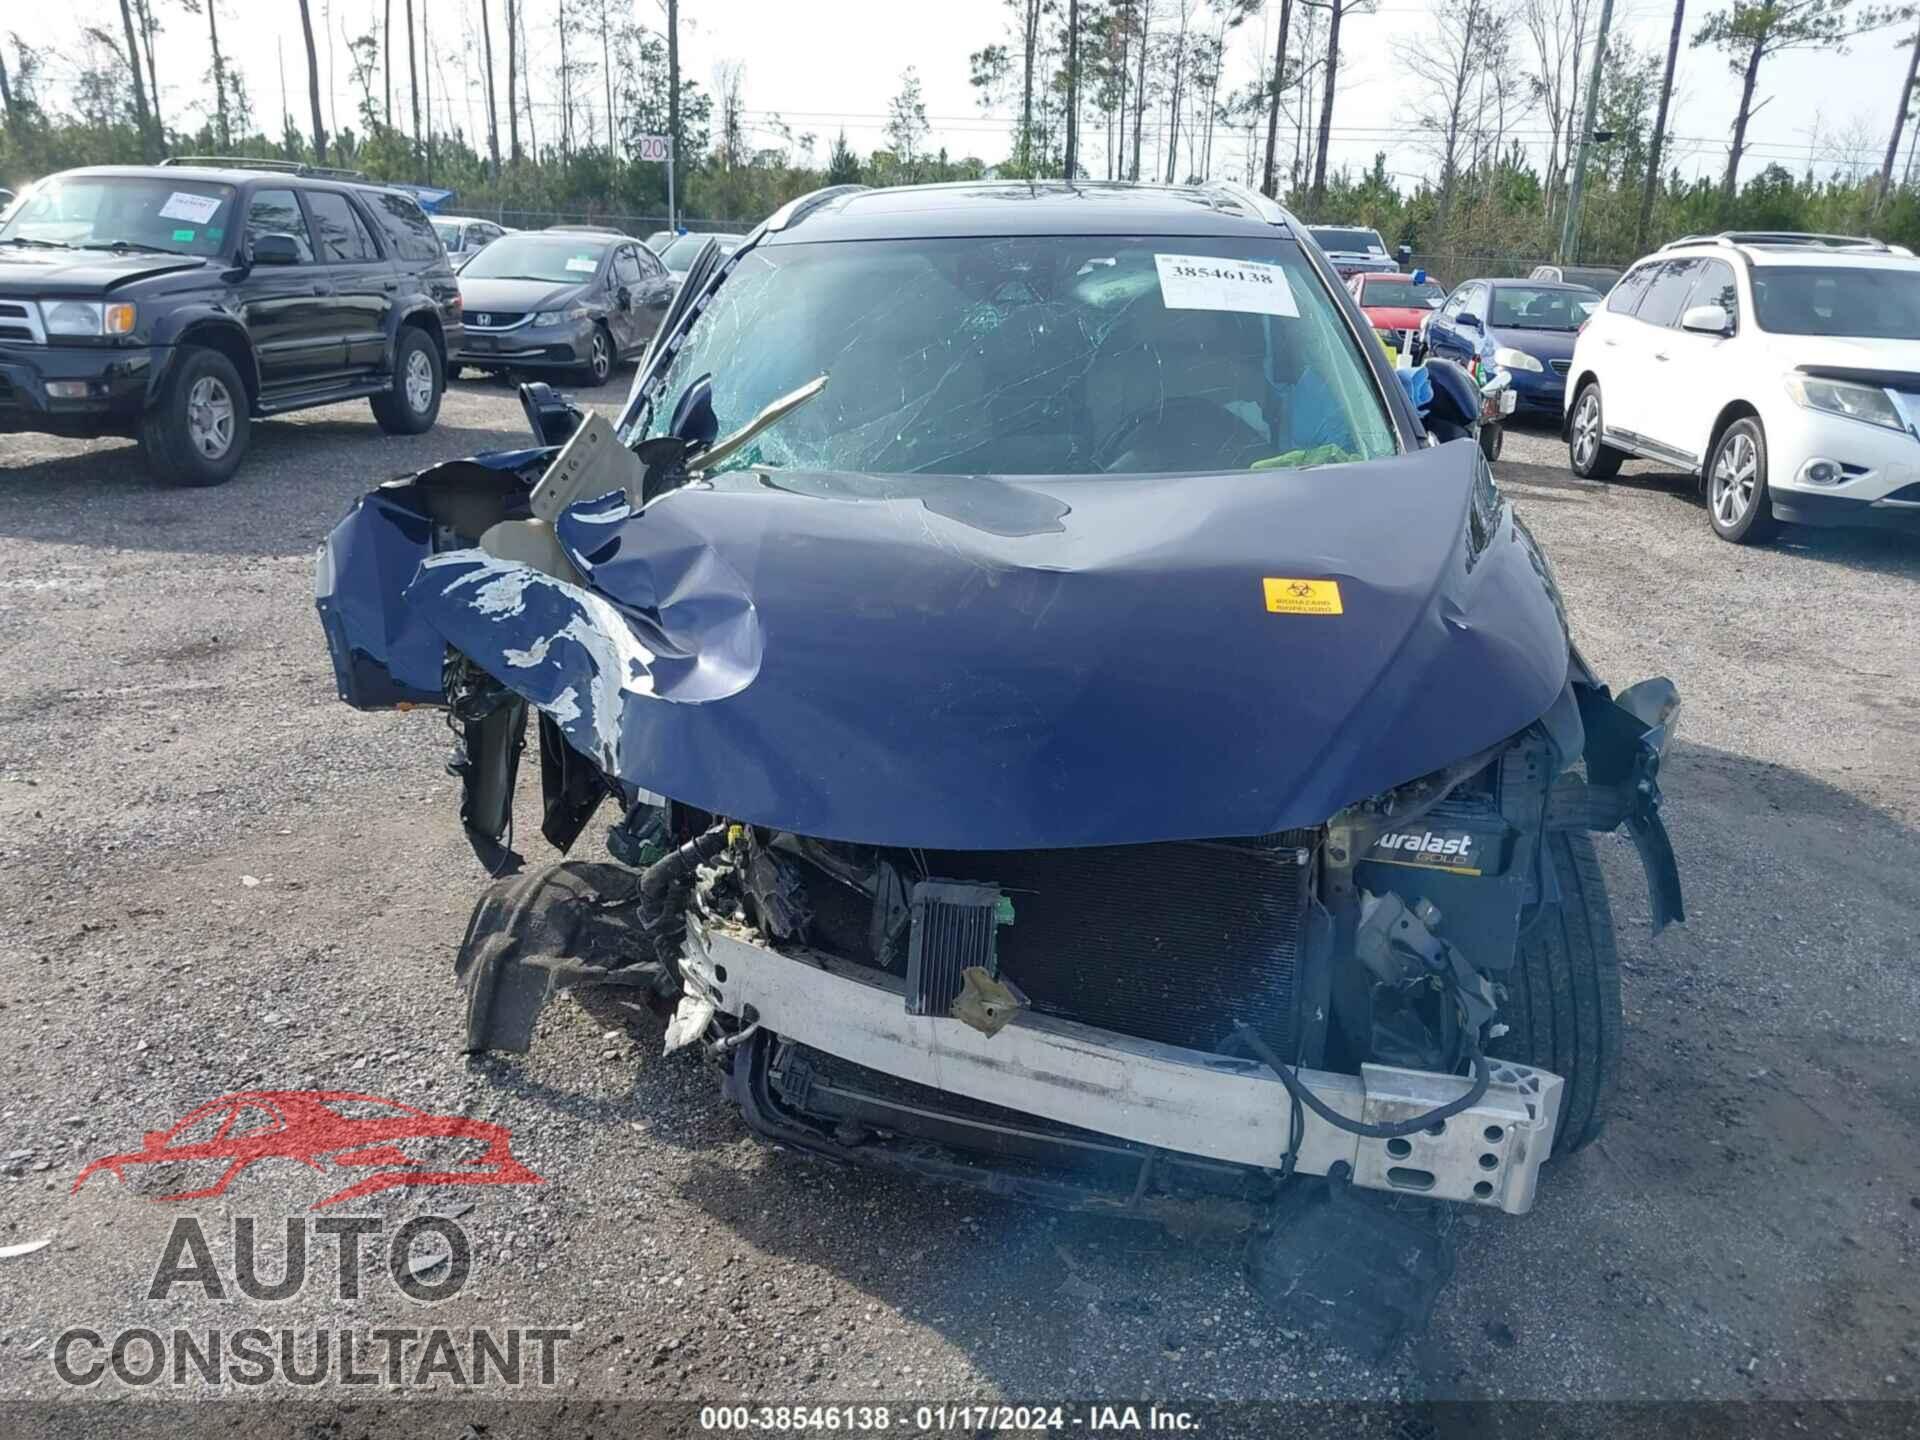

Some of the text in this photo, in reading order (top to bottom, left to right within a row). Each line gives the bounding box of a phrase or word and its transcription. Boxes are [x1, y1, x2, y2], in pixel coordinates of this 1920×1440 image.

[643, 139, 663, 158] 20
[1172, 265, 1273, 284] 38546138
[1374, 831, 1472, 856] uralast
[1415, 852, 1467, 864] GOLD
